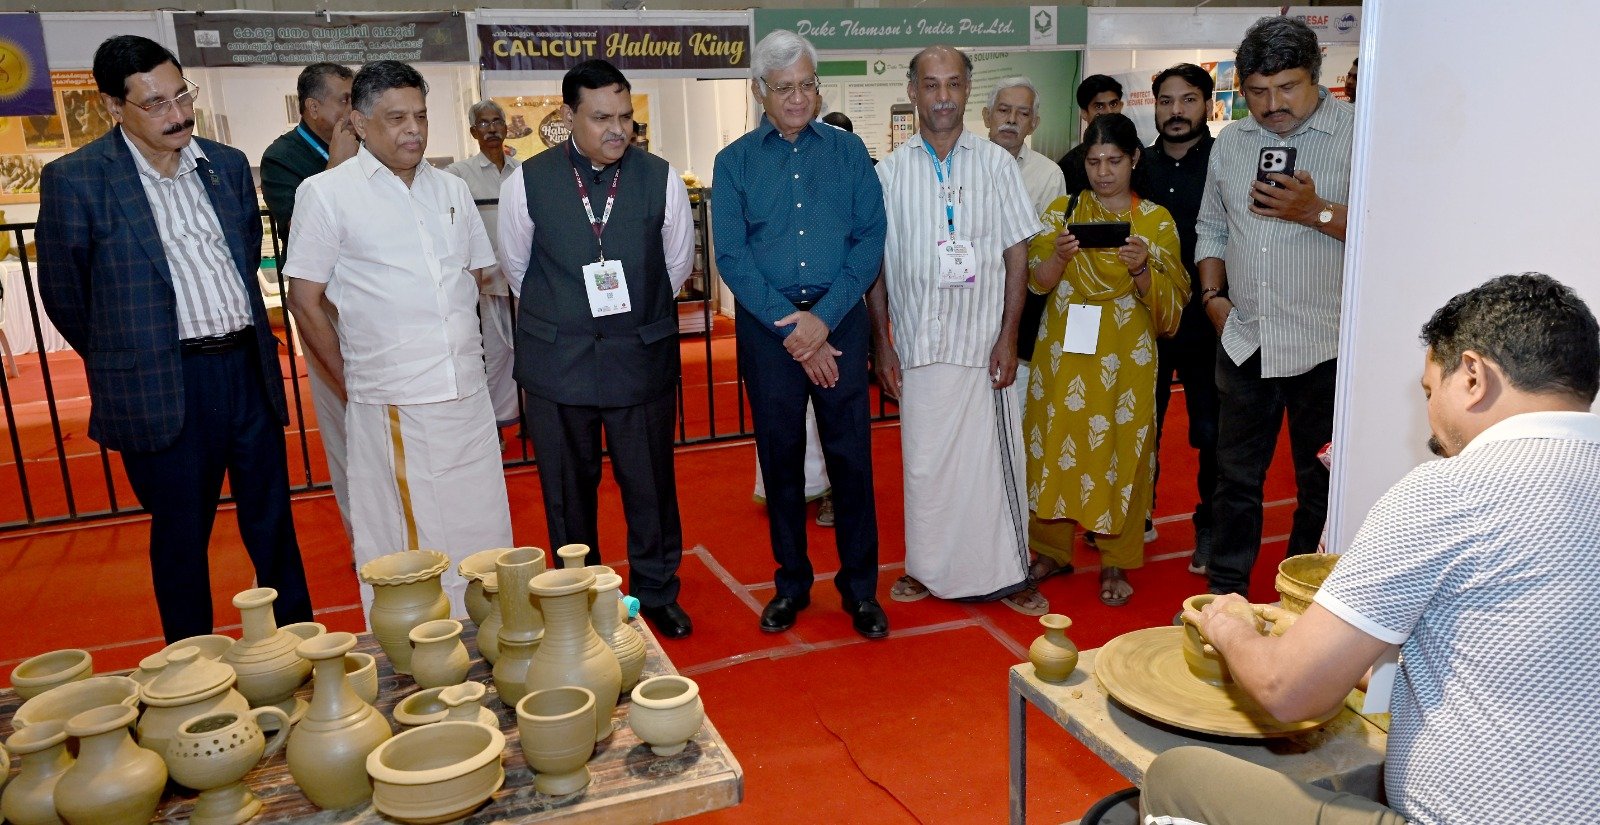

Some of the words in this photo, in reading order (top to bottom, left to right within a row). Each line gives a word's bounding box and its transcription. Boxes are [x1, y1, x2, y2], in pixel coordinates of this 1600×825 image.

[797, 19, 836, 36] Duke
[840, 18, 912, 37] Thomson's
[917, 18, 954, 35] India
[1305, 15, 1329, 25] ESAF
[233, 27, 275, 41] കേരള
[277, 27, 310, 39] വനം
[372, 23, 417, 40] വകുപ്പ്
[492, 39, 597, 57] CALICUT
[605, 32, 683, 58] Halwa
[688, 32, 745, 65] King
[973, 52, 1009, 62] SOLUTIONS
